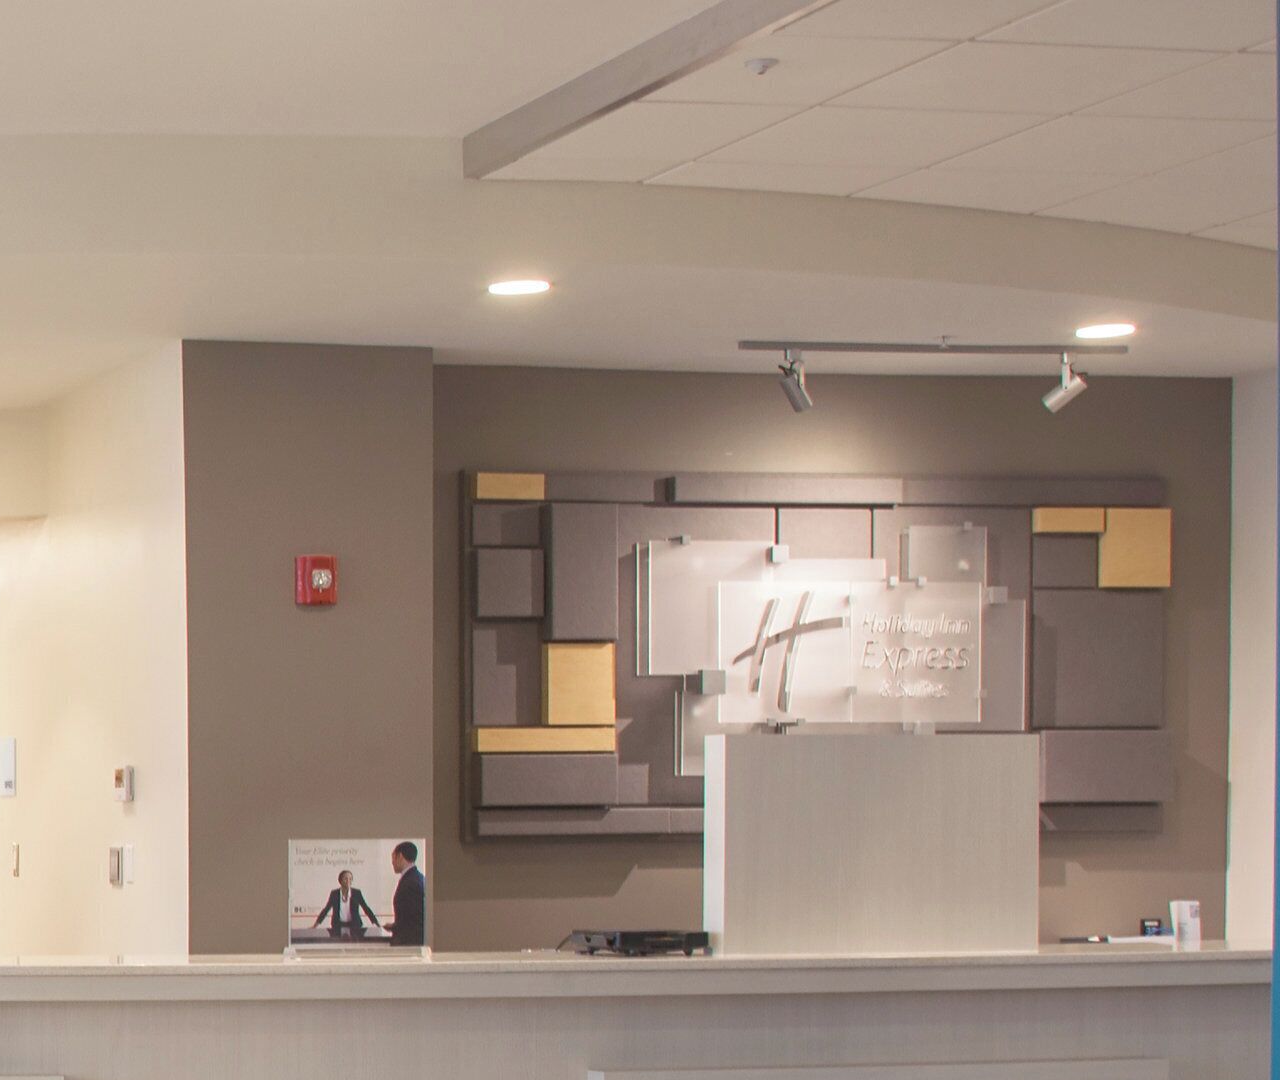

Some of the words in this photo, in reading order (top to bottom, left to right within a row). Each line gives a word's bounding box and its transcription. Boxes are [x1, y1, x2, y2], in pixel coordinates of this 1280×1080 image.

[862, 613, 936, 640] Holiday
[939, 612, 970, 634] Inn
[862, 640, 970, 677] Express
